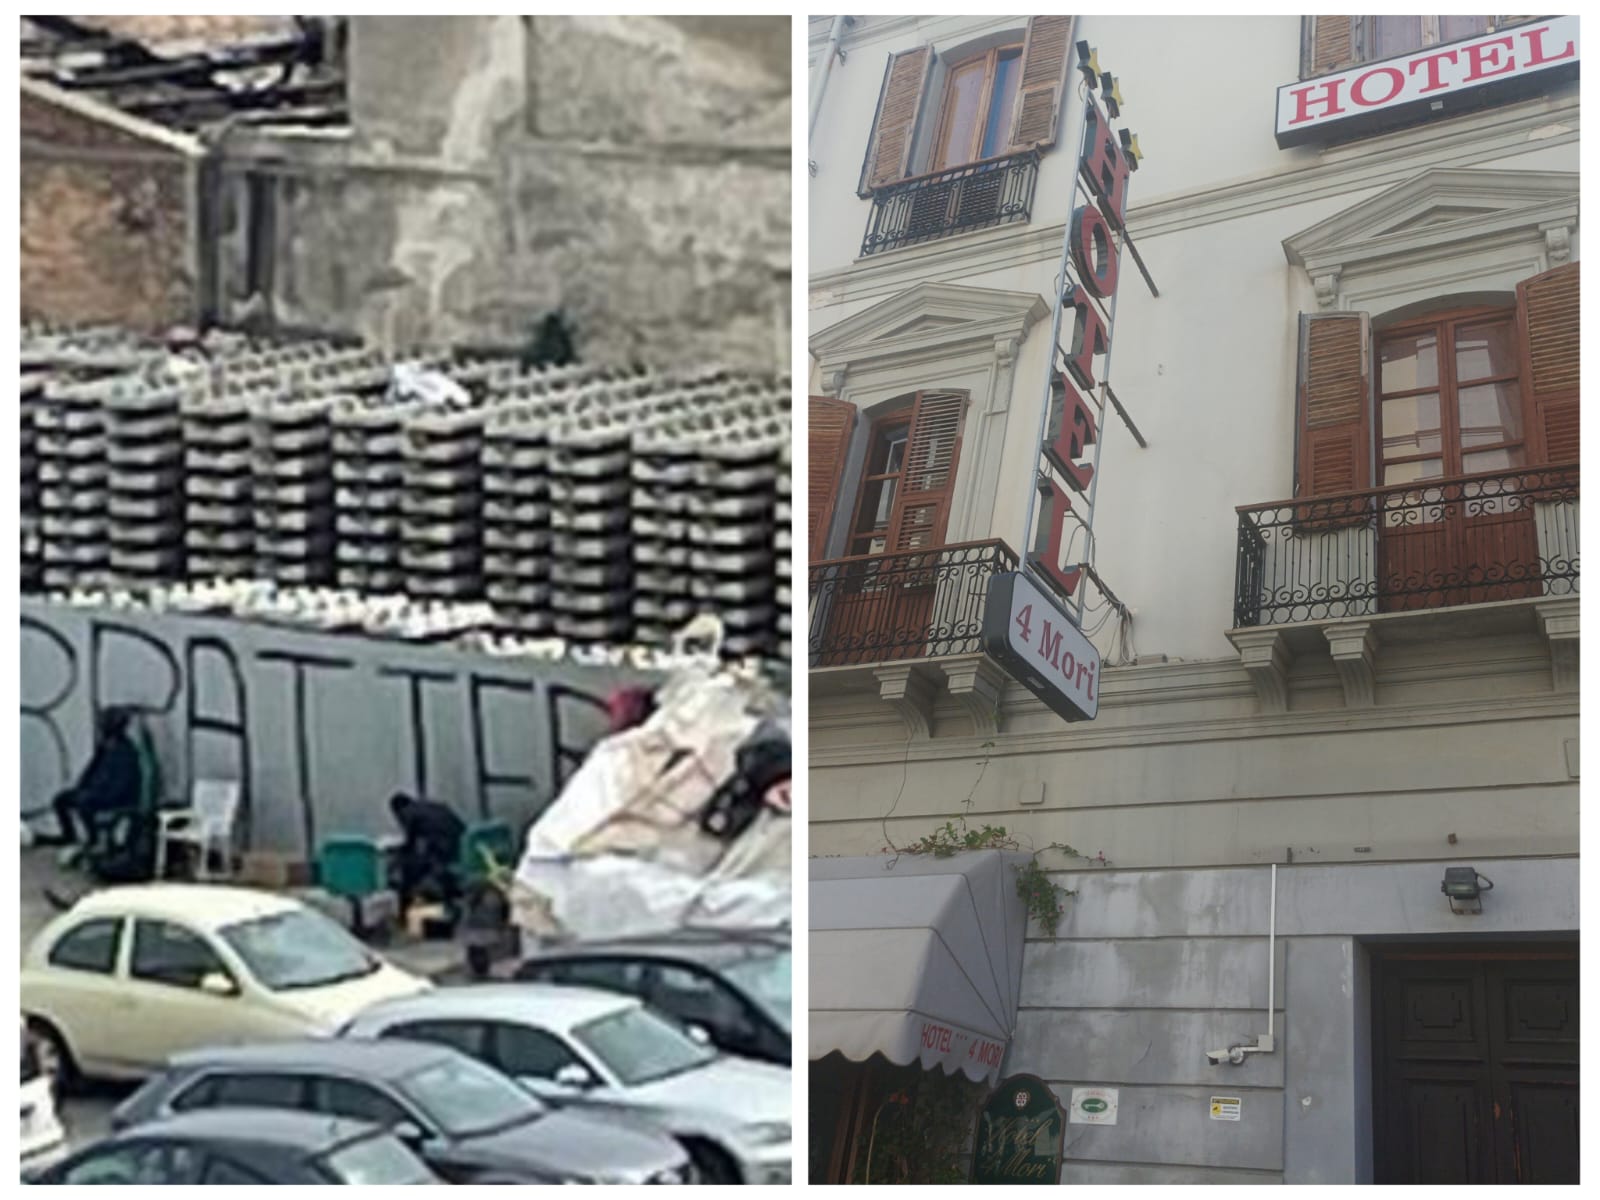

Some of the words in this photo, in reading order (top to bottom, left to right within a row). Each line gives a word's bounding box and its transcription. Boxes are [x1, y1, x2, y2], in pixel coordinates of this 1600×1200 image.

[1288, 27, 1575, 125] HOTEL
[1026, 103, 1128, 596] HOTEL
[1016, 604, 1032, 643] 4
[1037, 619, 1096, 701] Mori
[921, 1023, 953, 1054] HOTEL
[968, 1039, 978, 1059] 4
[977, 1041, 1004, 1068] MORI
